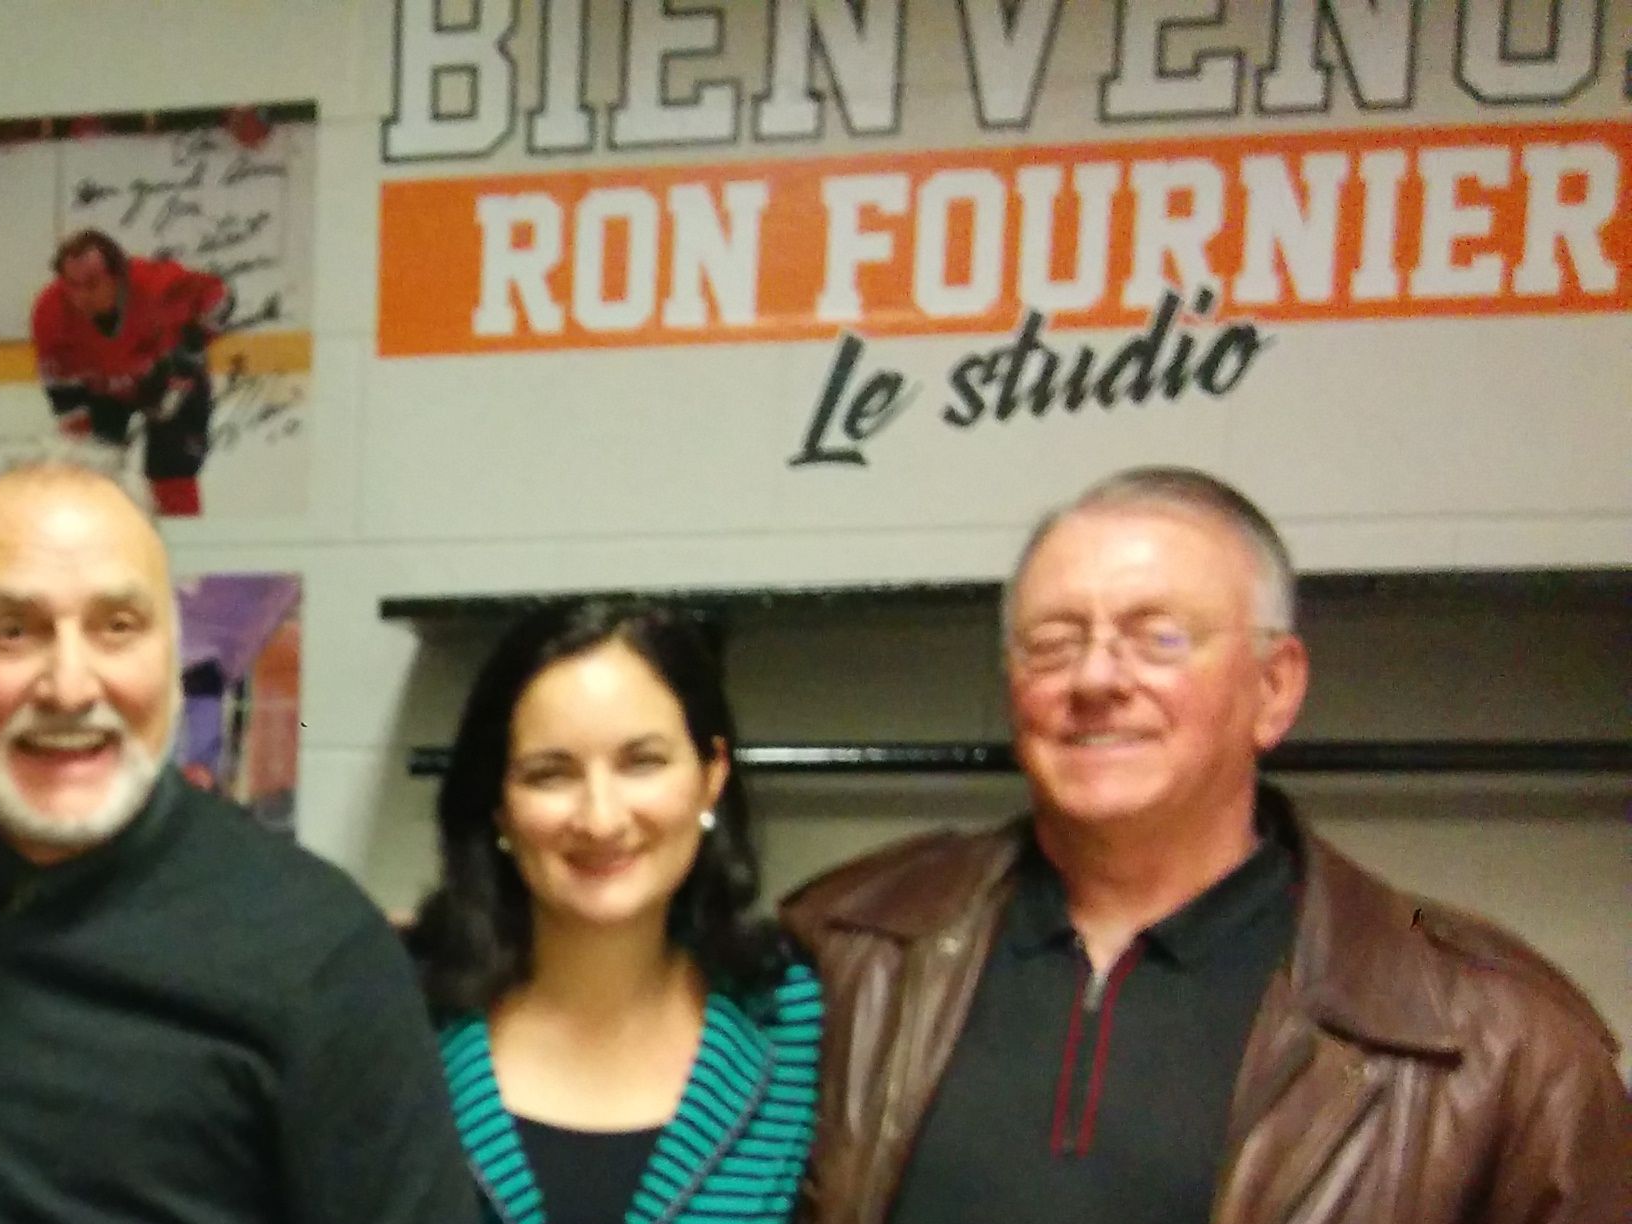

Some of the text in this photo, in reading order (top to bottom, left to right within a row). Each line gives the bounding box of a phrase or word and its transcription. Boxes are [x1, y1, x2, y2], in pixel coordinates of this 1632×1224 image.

[471, 180, 770, 337] RON
[813, 140, 1620, 323] FOURNIER
[787, 283, 1274, 467] Le studio
